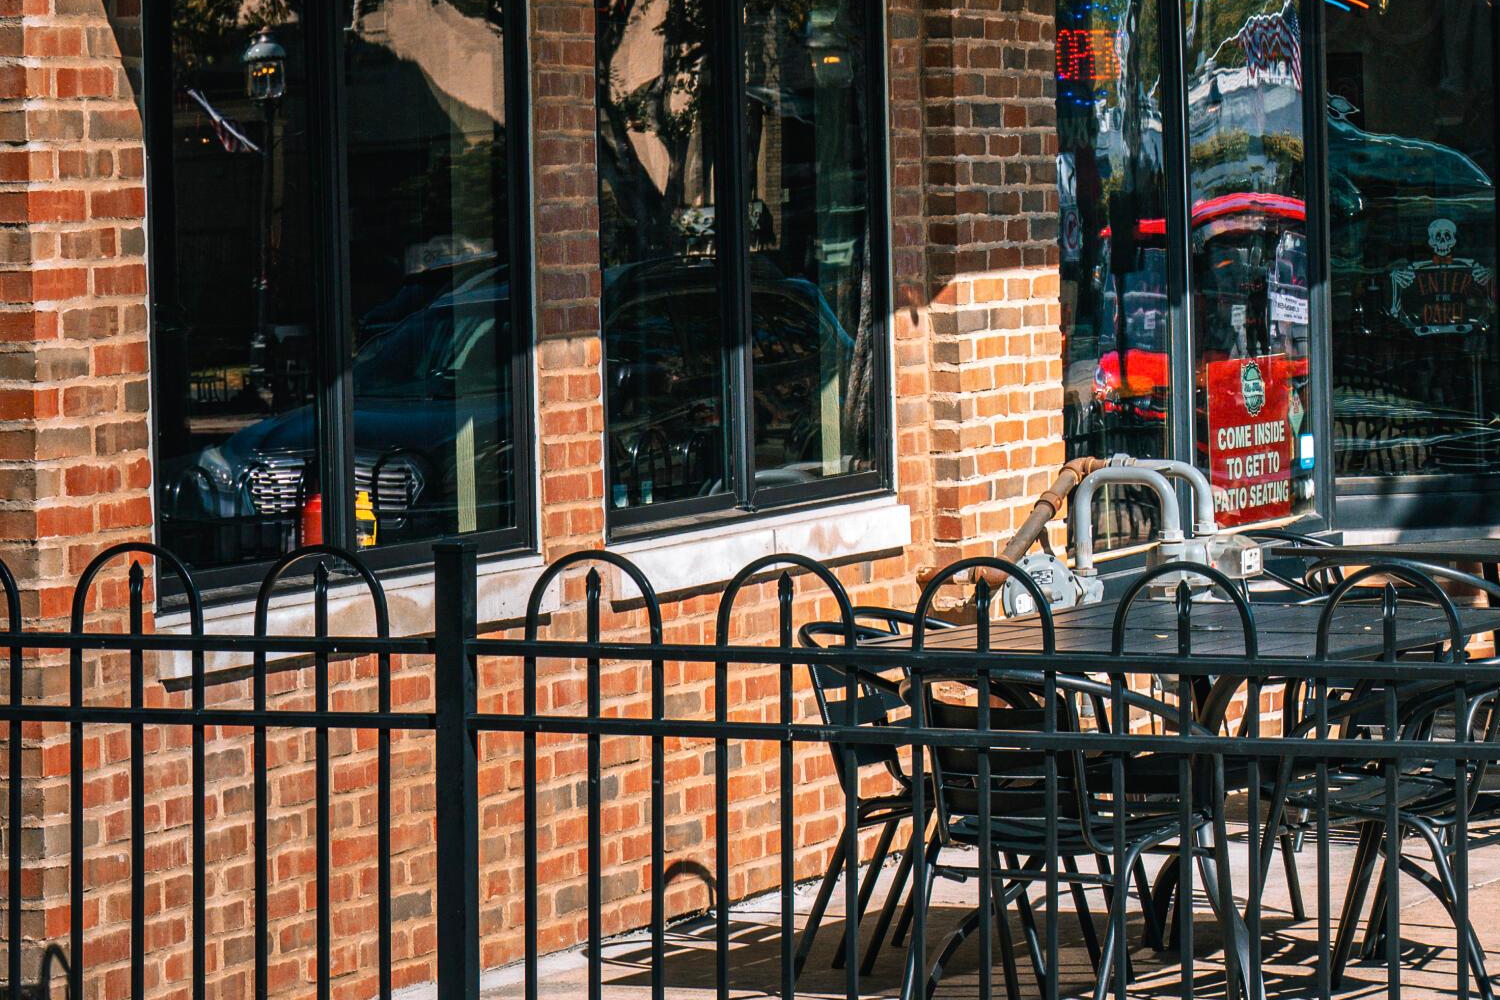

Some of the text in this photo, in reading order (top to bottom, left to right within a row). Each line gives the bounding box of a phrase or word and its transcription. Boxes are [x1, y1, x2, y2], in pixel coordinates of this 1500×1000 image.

[1055, 28, 1122, 80] OPEN
[1217, 420, 1285, 451] COME INSIDE
[1226, 451, 1280, 480] TO GET TO
[1213, 481, 1289, 513] PATIO SEATING
